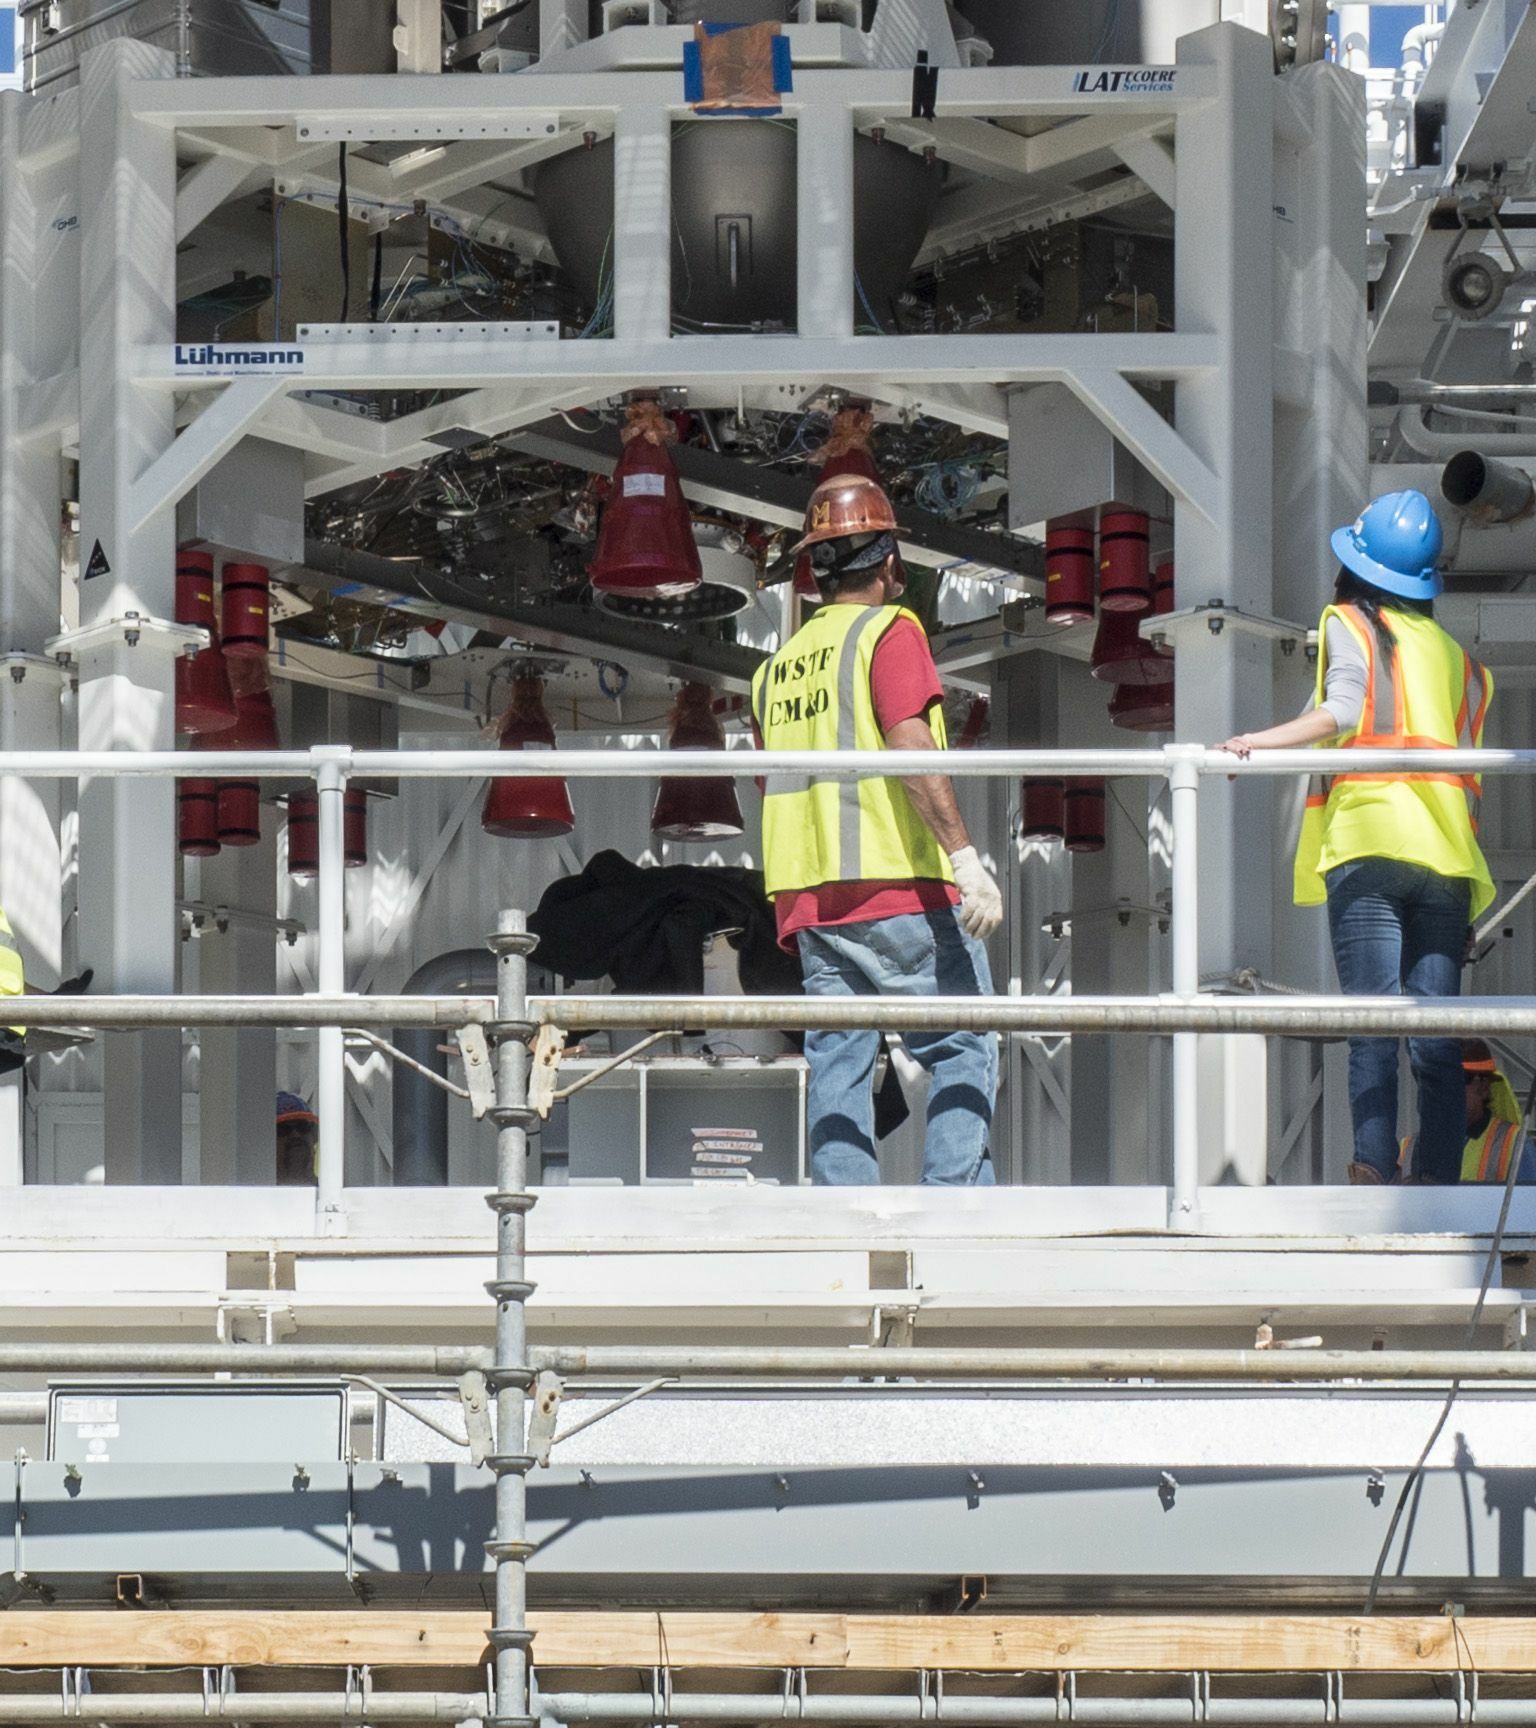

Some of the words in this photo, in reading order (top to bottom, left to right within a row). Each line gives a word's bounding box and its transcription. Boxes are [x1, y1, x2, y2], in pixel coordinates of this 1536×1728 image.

[175, 345, 304, 365] Lühmann
[774, 646, 835, 685] WSTF
[769, 688, 829, 727] CM&O
